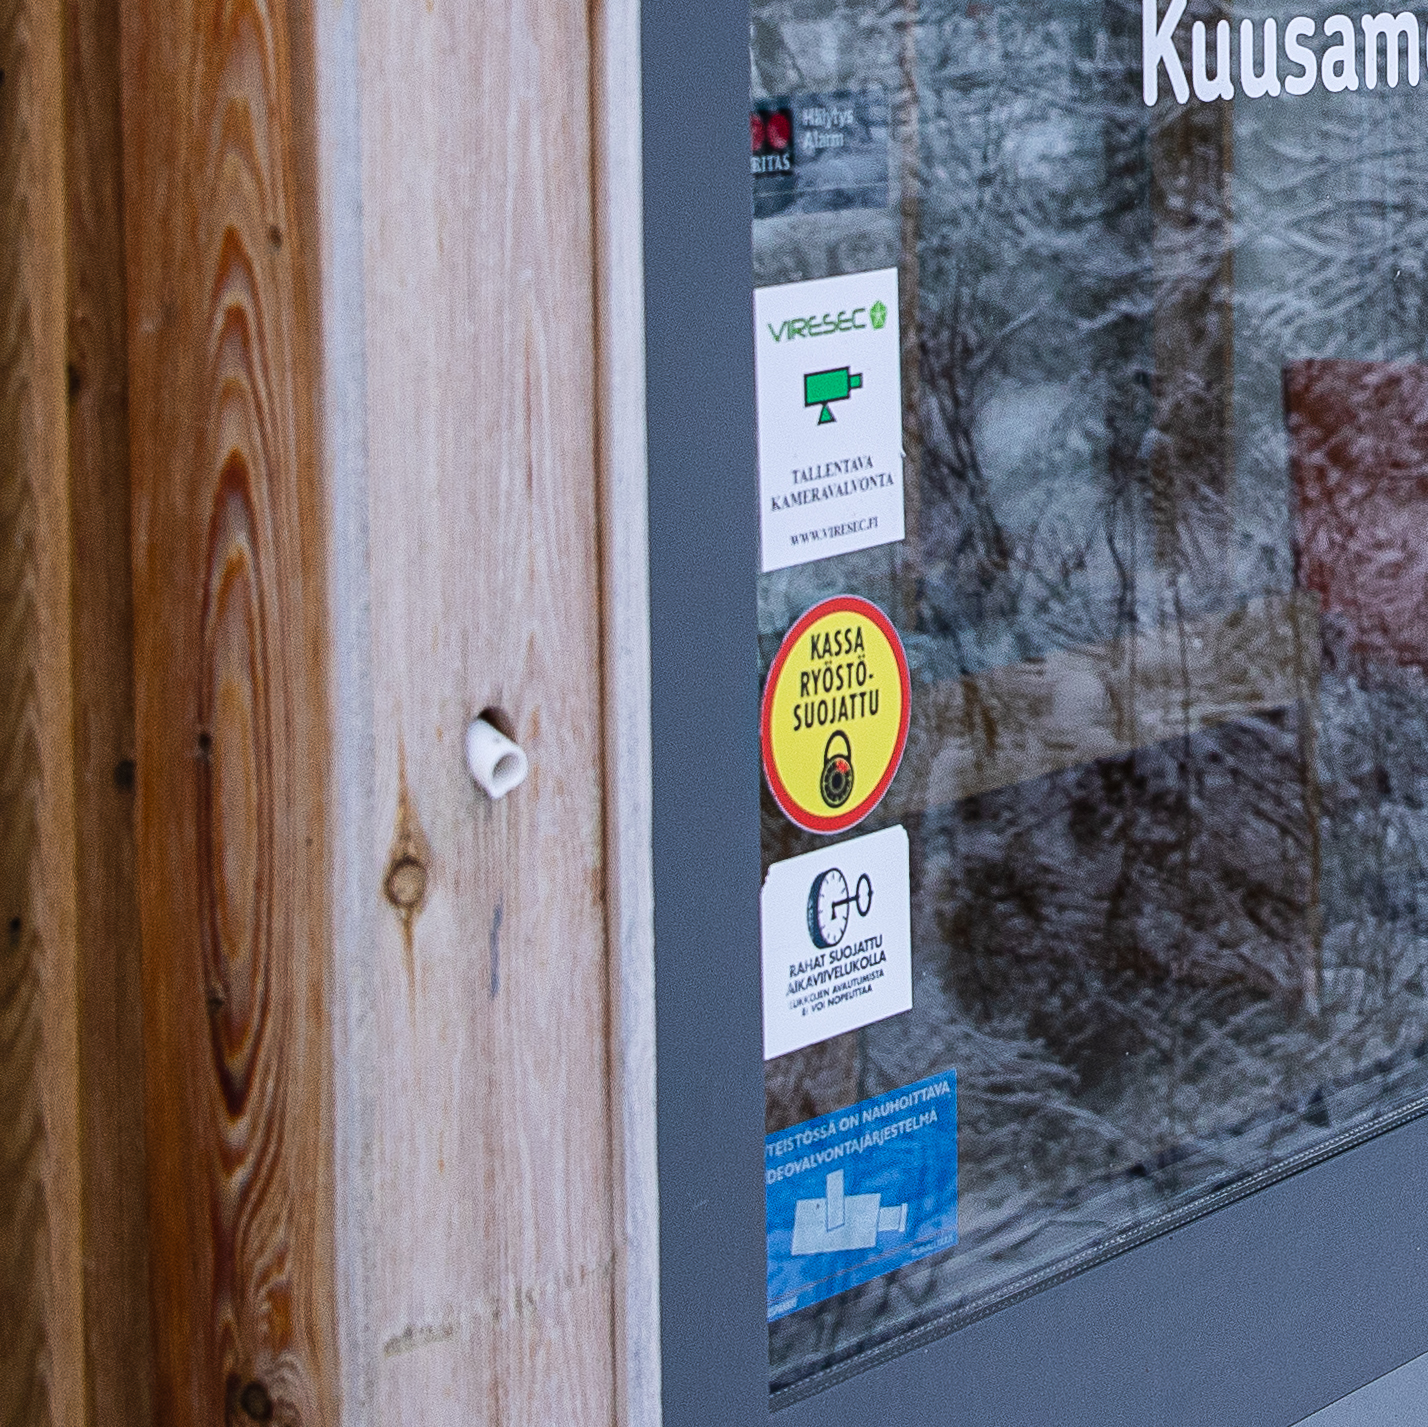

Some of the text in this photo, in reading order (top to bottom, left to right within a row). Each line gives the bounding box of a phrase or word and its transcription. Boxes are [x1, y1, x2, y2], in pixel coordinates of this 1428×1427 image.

[767, 307, 866, 343] VIRESEC
[792, 454, 874, 485] TALLENTAVA
[771, 471, 894, 512] KAMERAVALVONTA
[789, 515, 879, 547] WWW.VIRESEC.FI
[810, 626, 865, 661] KASSA
[800, 653, 874, 698] RYÖSTÖ-
[793, 688, 880, 732] SUOJATTU
[786, 950, 887, 997] AIKAVIIVELUKOLLA
[789, 934, 883, 978] RAHAT SUOJATTU
[838, 1113, 860, 1133] ON
[861, 1080, 951, 1124] NAUHOITTAVA
